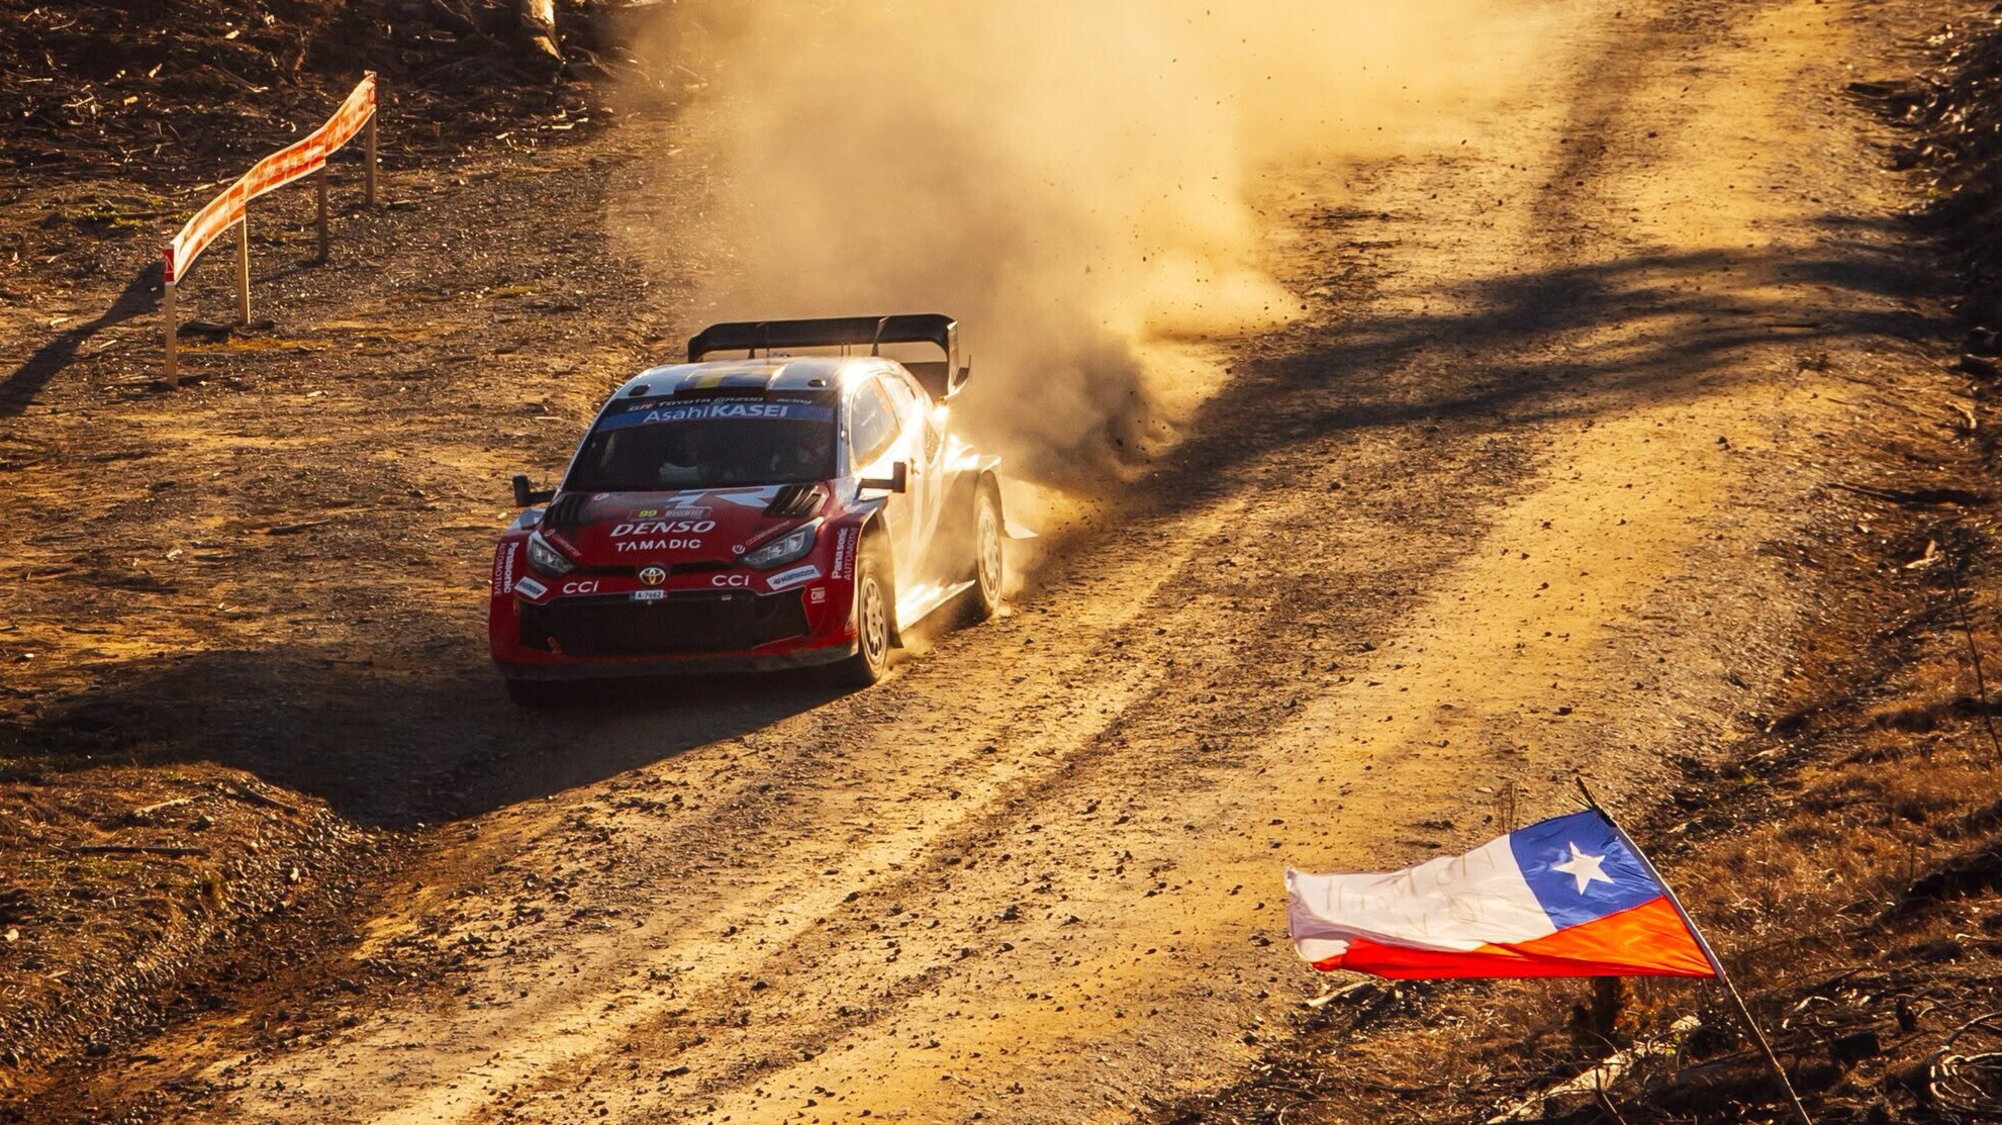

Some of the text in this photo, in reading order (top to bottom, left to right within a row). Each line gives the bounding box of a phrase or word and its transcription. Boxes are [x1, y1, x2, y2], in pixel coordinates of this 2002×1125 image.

[657, 397, 712, 408] TOYOTA
[610, 520, 716, 537] DENSO
[615, 539, 702, 553] TAMADIC
[831, 527, 849, 580] Panasonic
[562, 580, 600, 594] CCI
[711, 574, 750, 587] CCI
